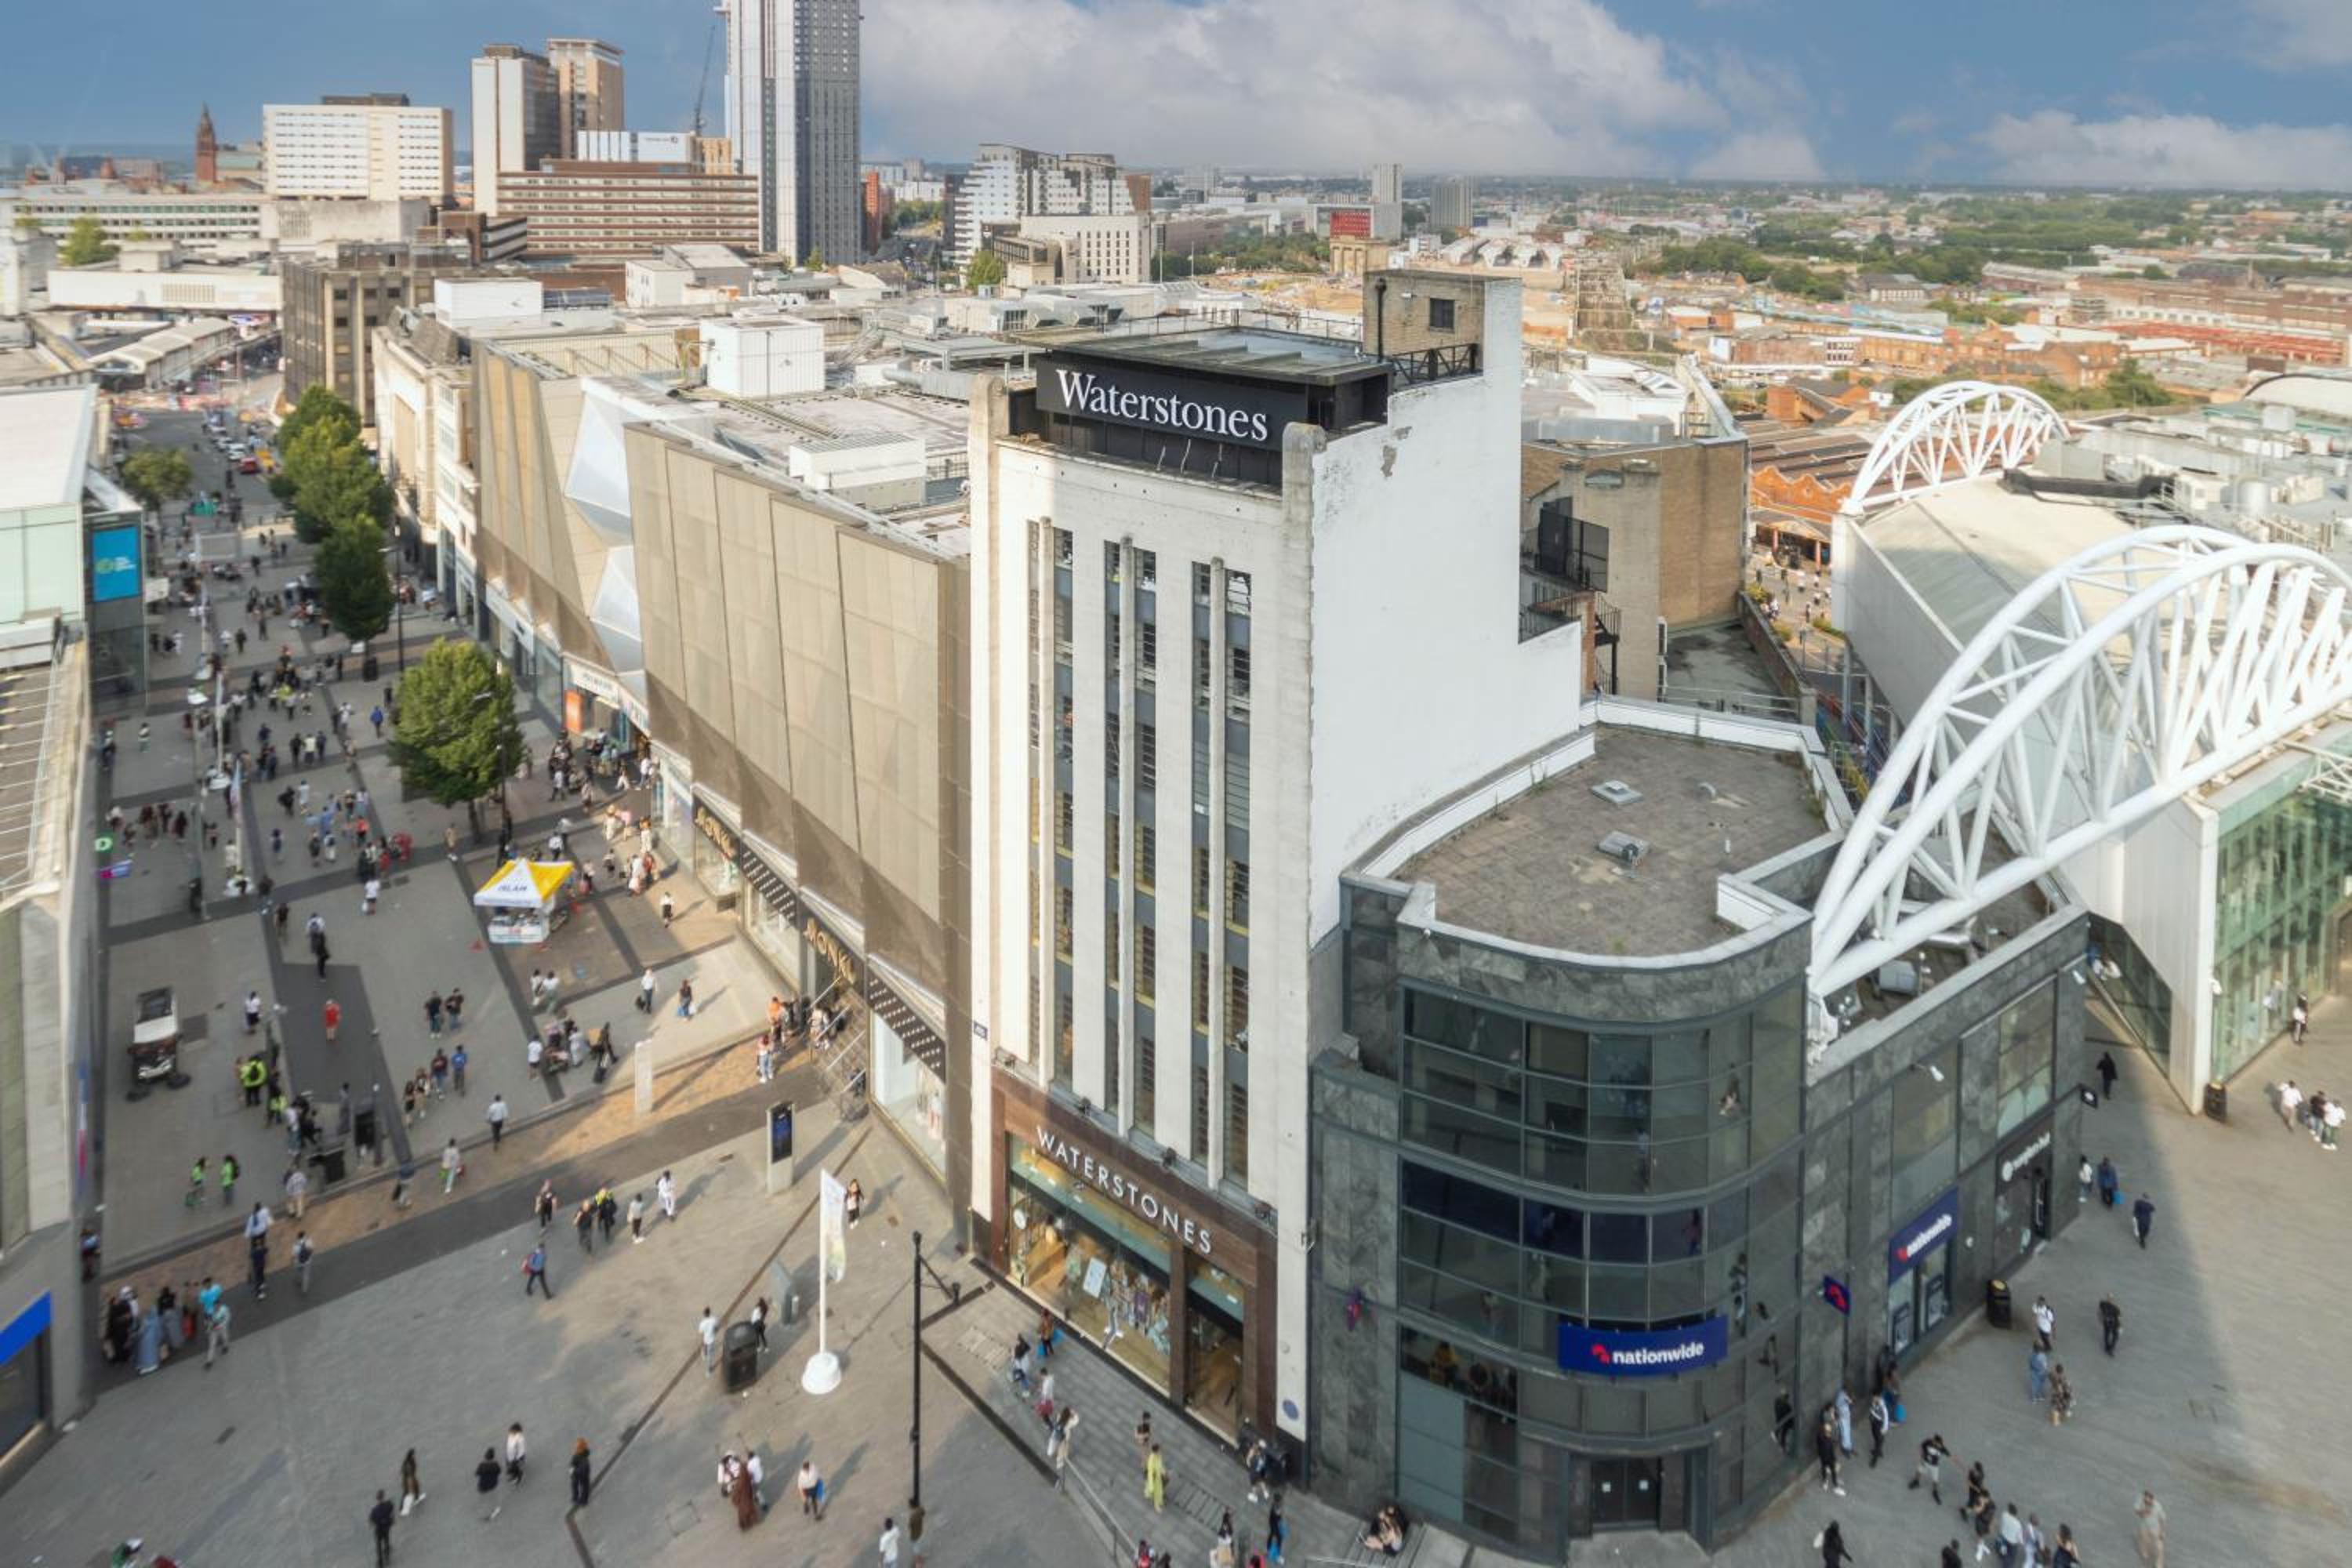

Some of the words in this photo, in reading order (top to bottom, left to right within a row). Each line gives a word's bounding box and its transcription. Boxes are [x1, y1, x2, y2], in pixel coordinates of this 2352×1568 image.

[1056, 368, 1269, 442] Waterstones
[1036, 1127, 1211, 1254] WATERSTONES
[1612, 1341, 1704, 1365] nationwide
